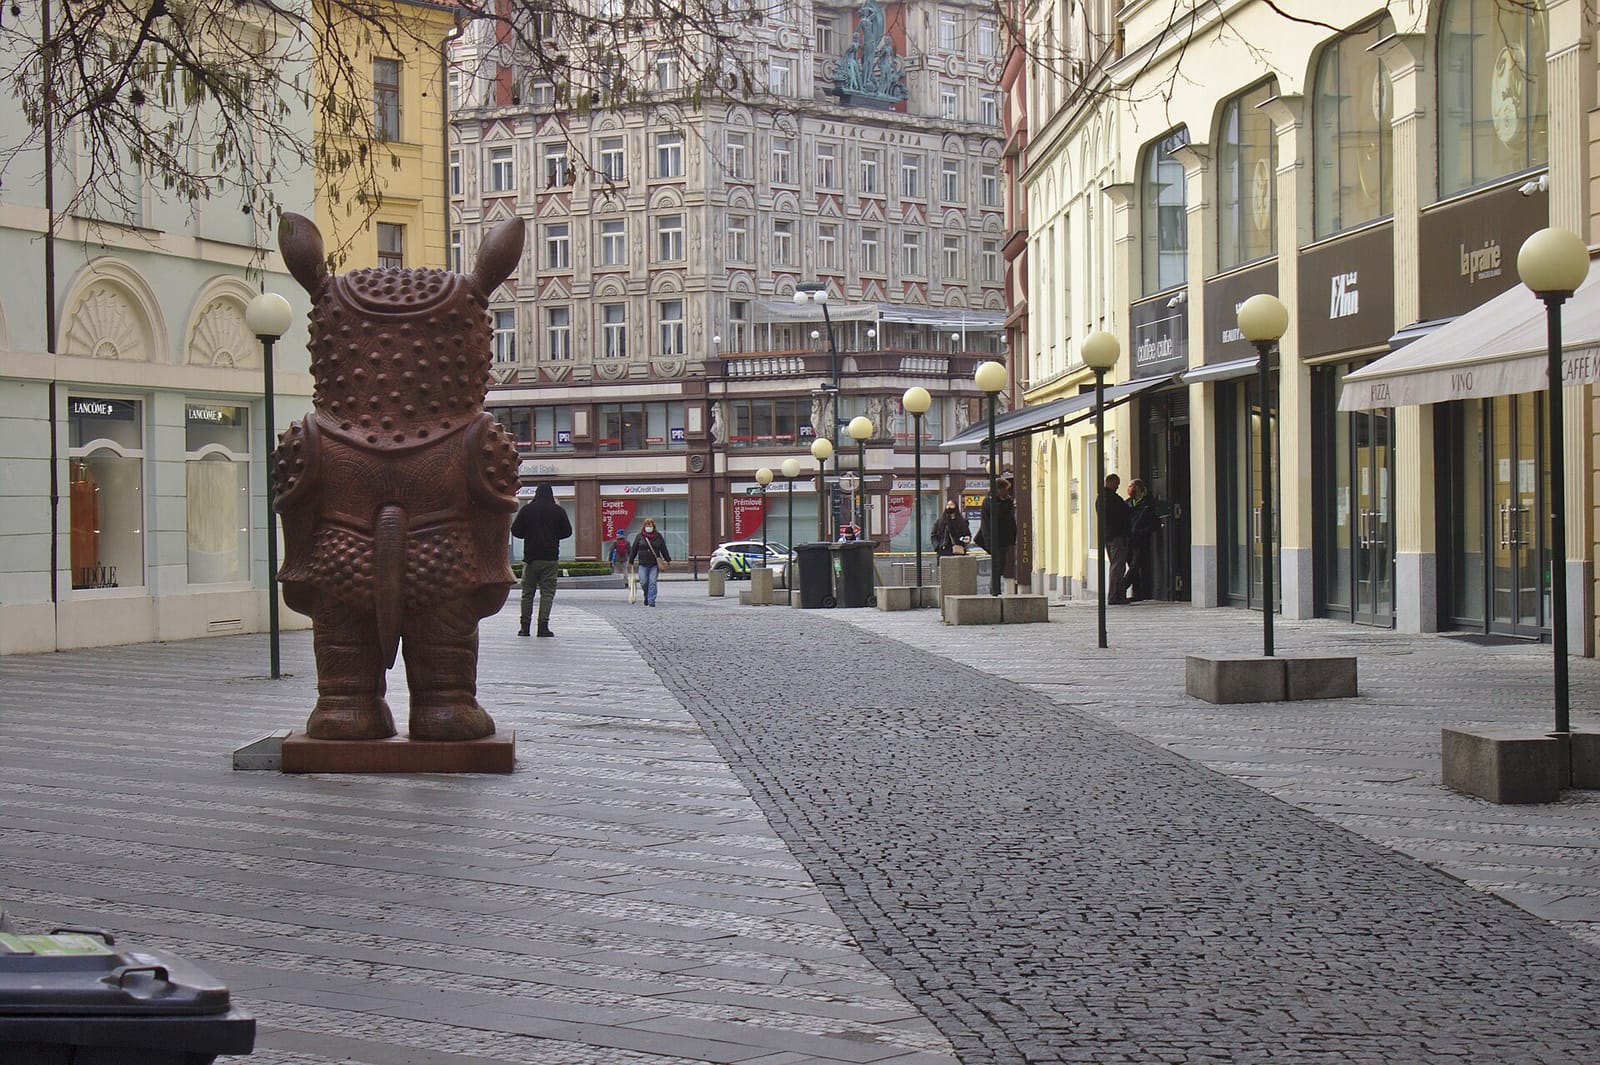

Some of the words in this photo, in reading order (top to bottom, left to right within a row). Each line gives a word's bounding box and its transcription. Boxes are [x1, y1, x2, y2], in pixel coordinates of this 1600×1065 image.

[880, 131, 921, 146] ADRIA
[1138, 339, 1156, 361] coffee
[1157, 335, 1172, 357] cube
[1371, 384, 1390, 400] PIZZA
[1452, 372, 1473, 392] VINO
[74, 402, 107, 415] LANCÔME
[188, 408, 217, 421] LANCÔME
[603, 500, 624, 509] Expert
